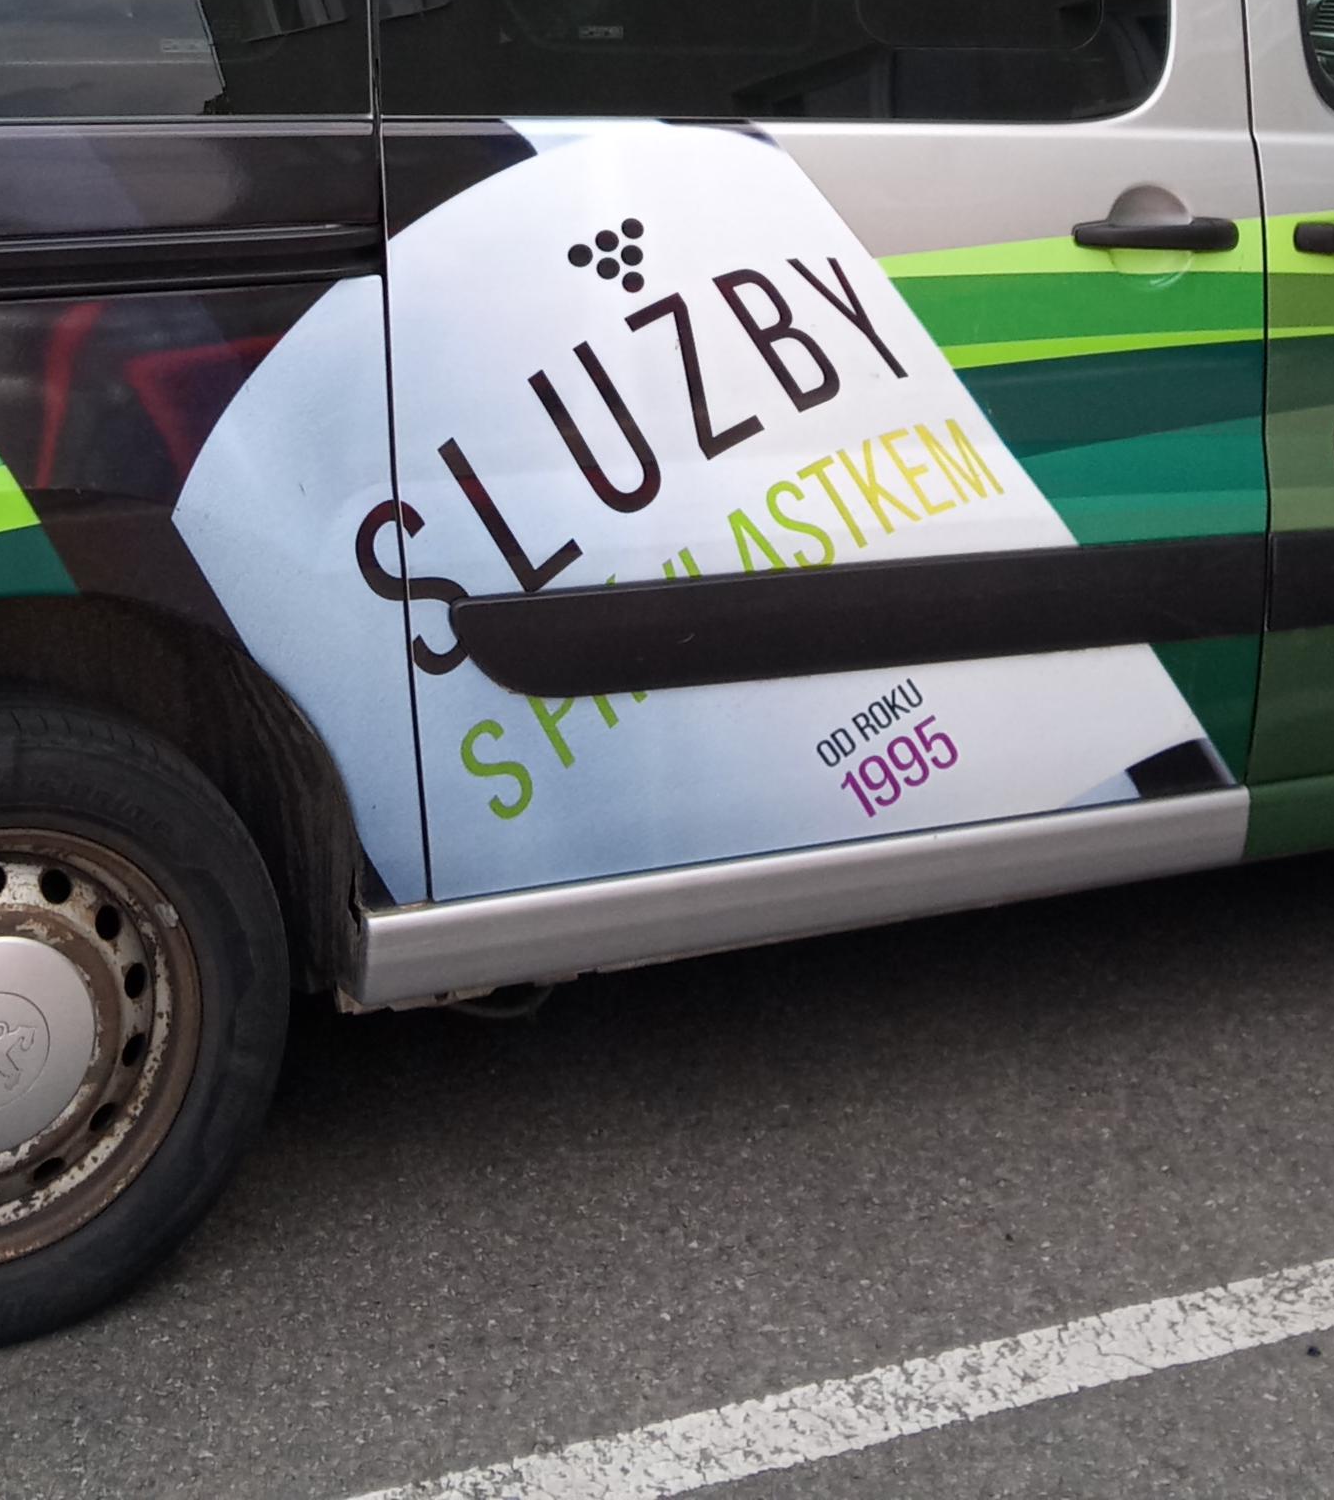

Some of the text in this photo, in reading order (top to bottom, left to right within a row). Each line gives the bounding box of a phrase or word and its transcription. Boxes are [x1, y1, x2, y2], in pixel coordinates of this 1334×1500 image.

[460, 719, 533, 819] S
[816, 678, 924, 768] OD ROKU
[840, 714, 959, 818] 1995
